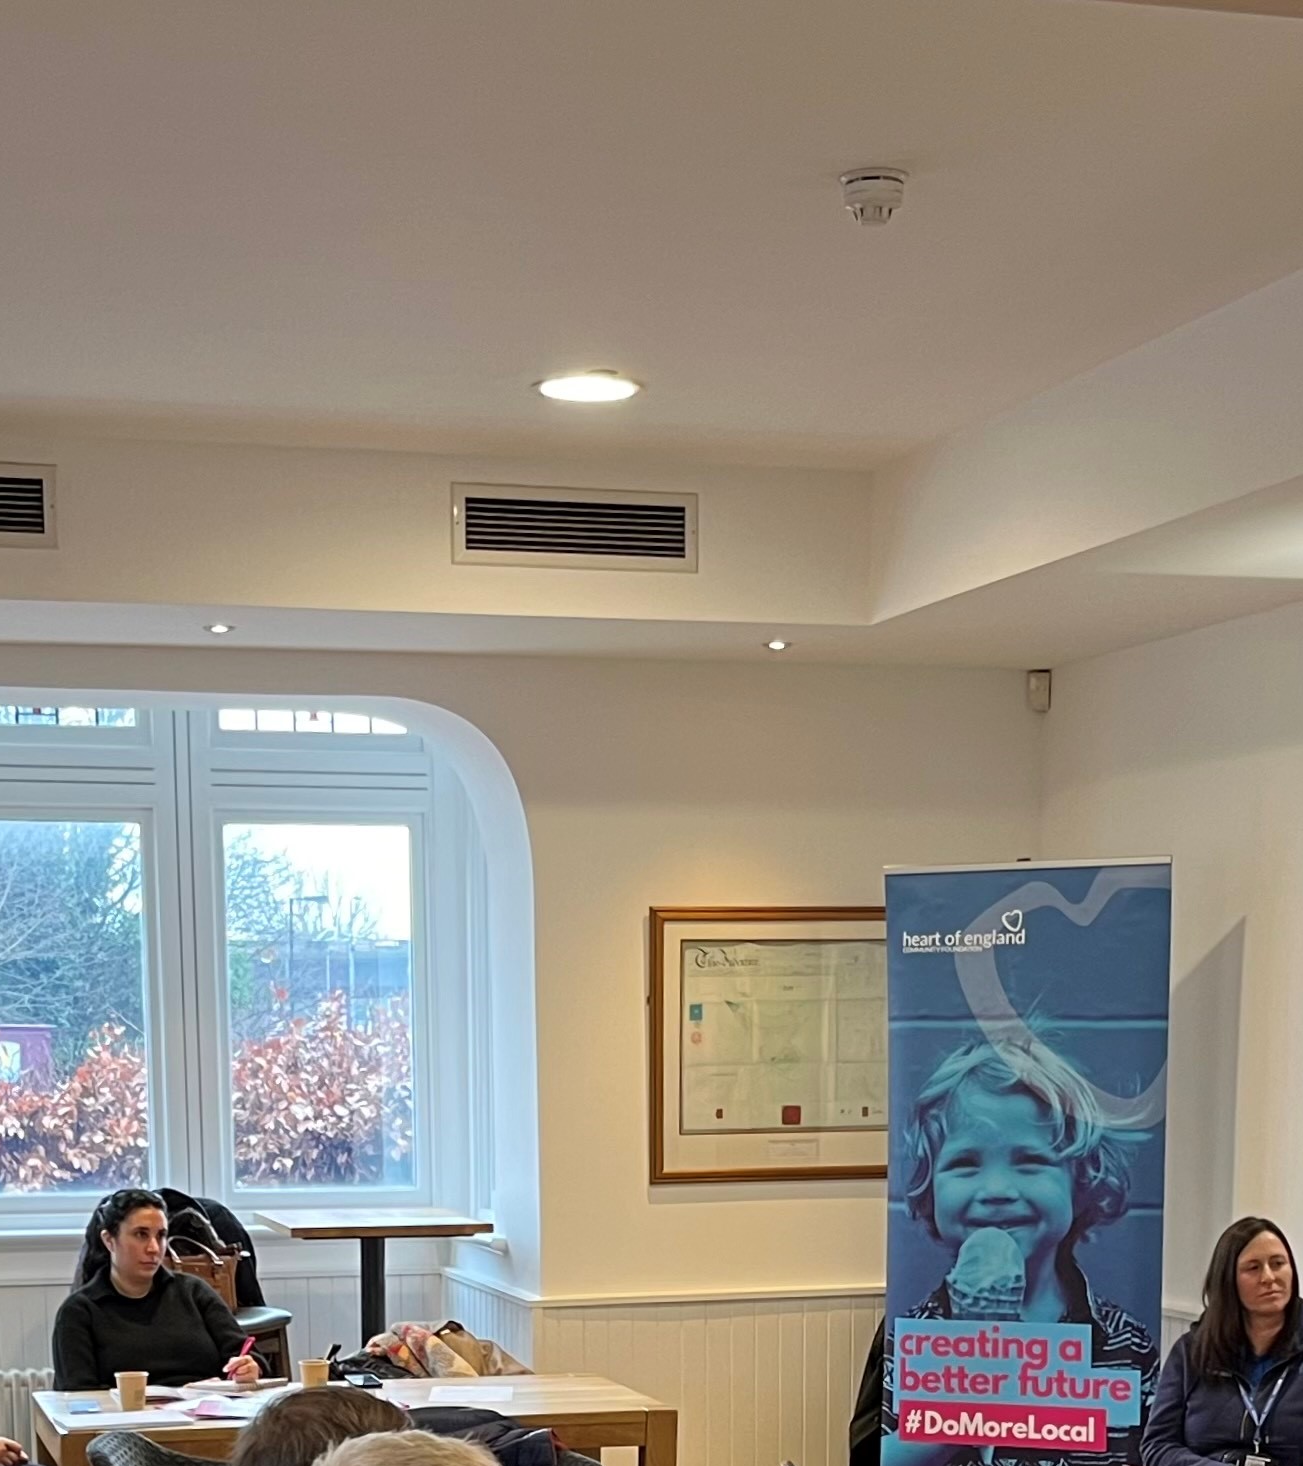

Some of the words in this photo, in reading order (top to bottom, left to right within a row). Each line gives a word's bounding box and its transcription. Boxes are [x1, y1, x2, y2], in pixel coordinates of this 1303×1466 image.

[902, 930, 941, 947] heart
[944, 930, 962, 946] of
[964, 928, 1026, 949] england
[899, 1325, 1049, 1370] creating
[1058, 1339, 1083, 1362] a
[899, 1357, 1009, 1395] better
[1017, 1361, 1132, 1401] future
[904, 1409, 1096, 1443] #DoMoreLocal
